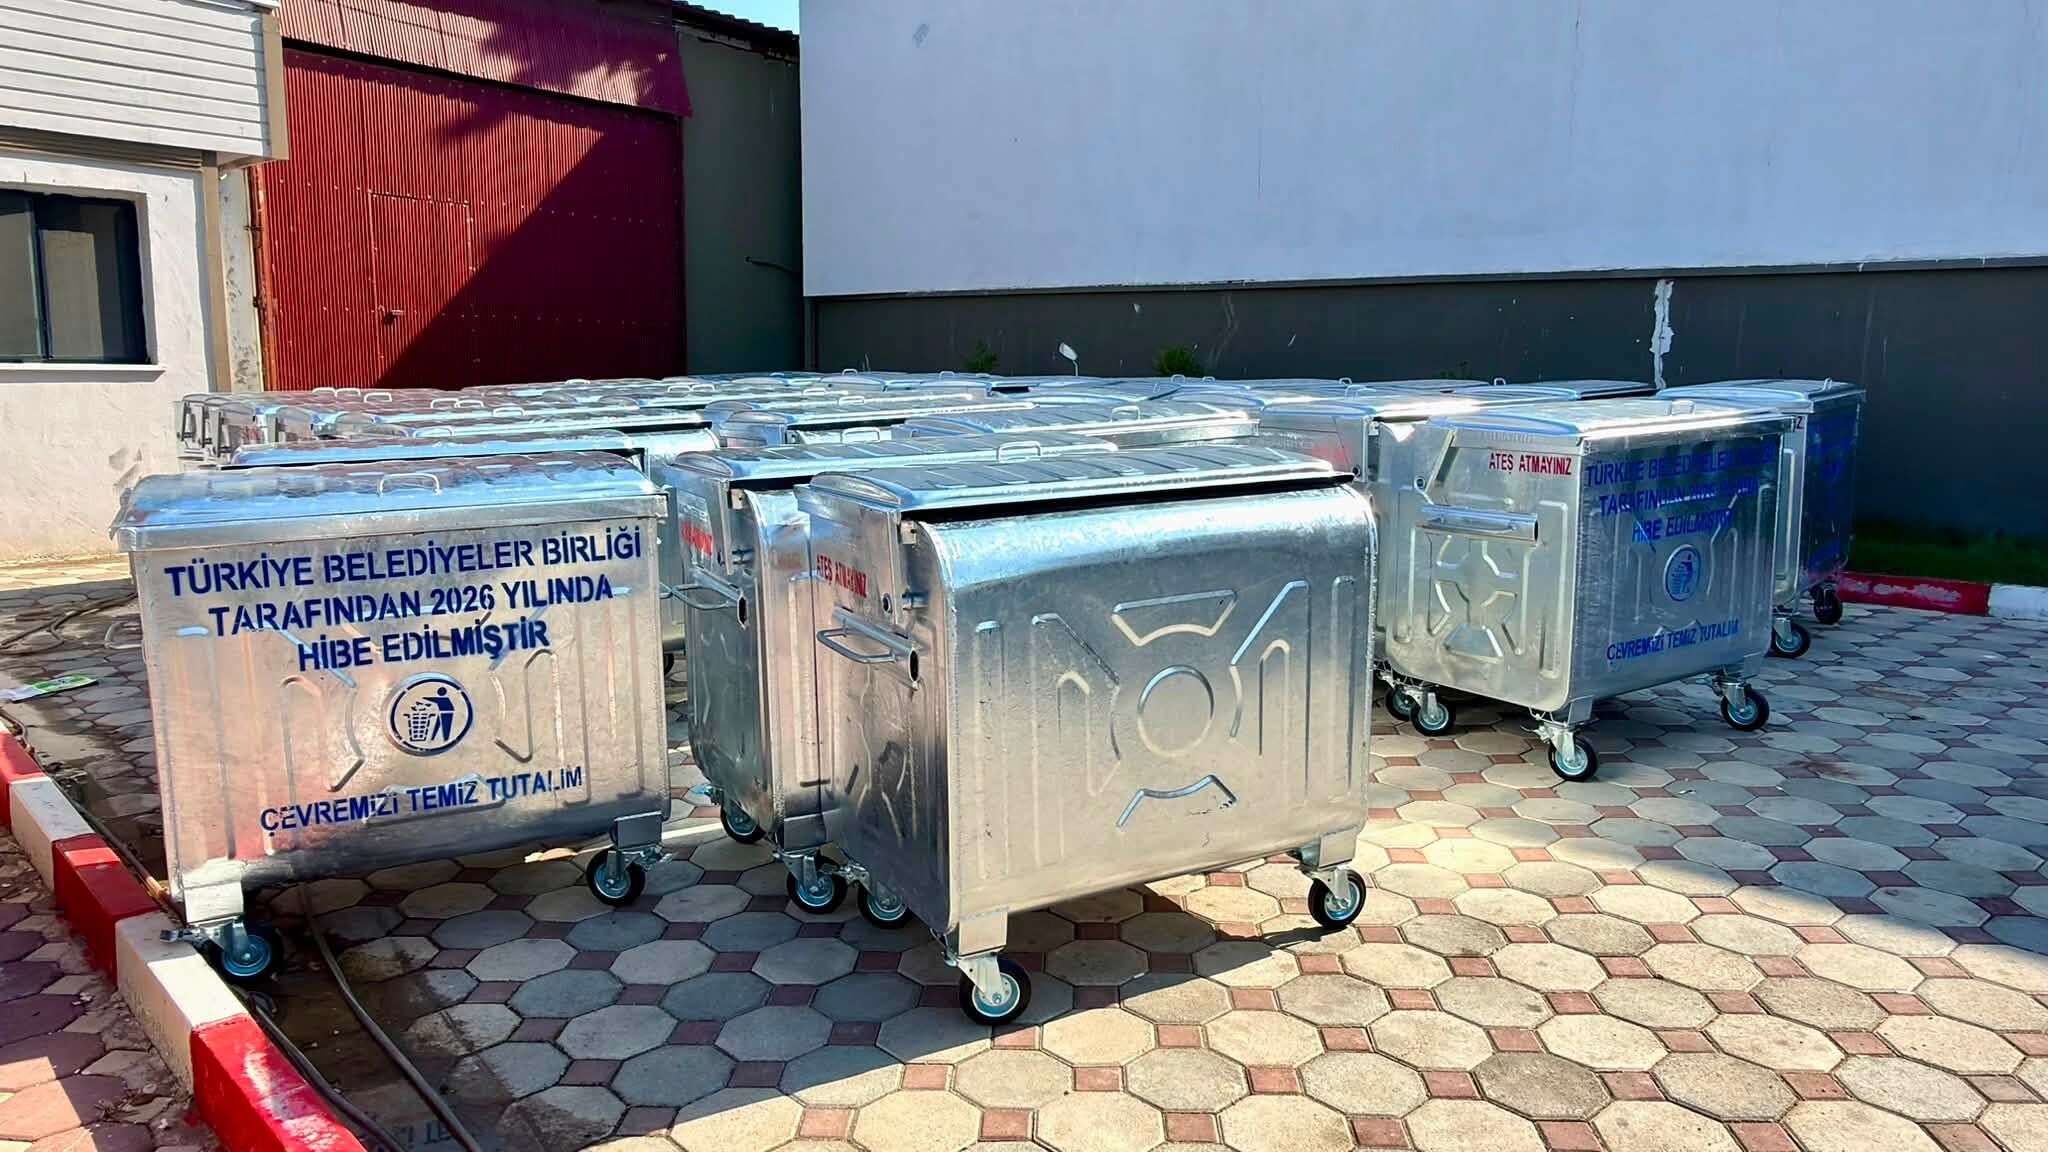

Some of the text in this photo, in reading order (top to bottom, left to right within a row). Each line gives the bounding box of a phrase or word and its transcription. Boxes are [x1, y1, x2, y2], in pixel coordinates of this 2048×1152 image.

[1488, 453, 1572, 476] ATEŞ ATMAYINIZ
[163, 552, 315, 597] TÜRKİYE
[323, 538, 536, 585] BELEDİYELER
[542, 525, 642, 566] BİRLİĞİ
[208, 574, 614, 637] TARAFINDAN 2026 YILINDA
[297, 615, 551, 673] HİBE EDİLMİŞTİR
[260, 766, 583, 838] ÇEVREMİZİ TEMİZ TUTALIM
